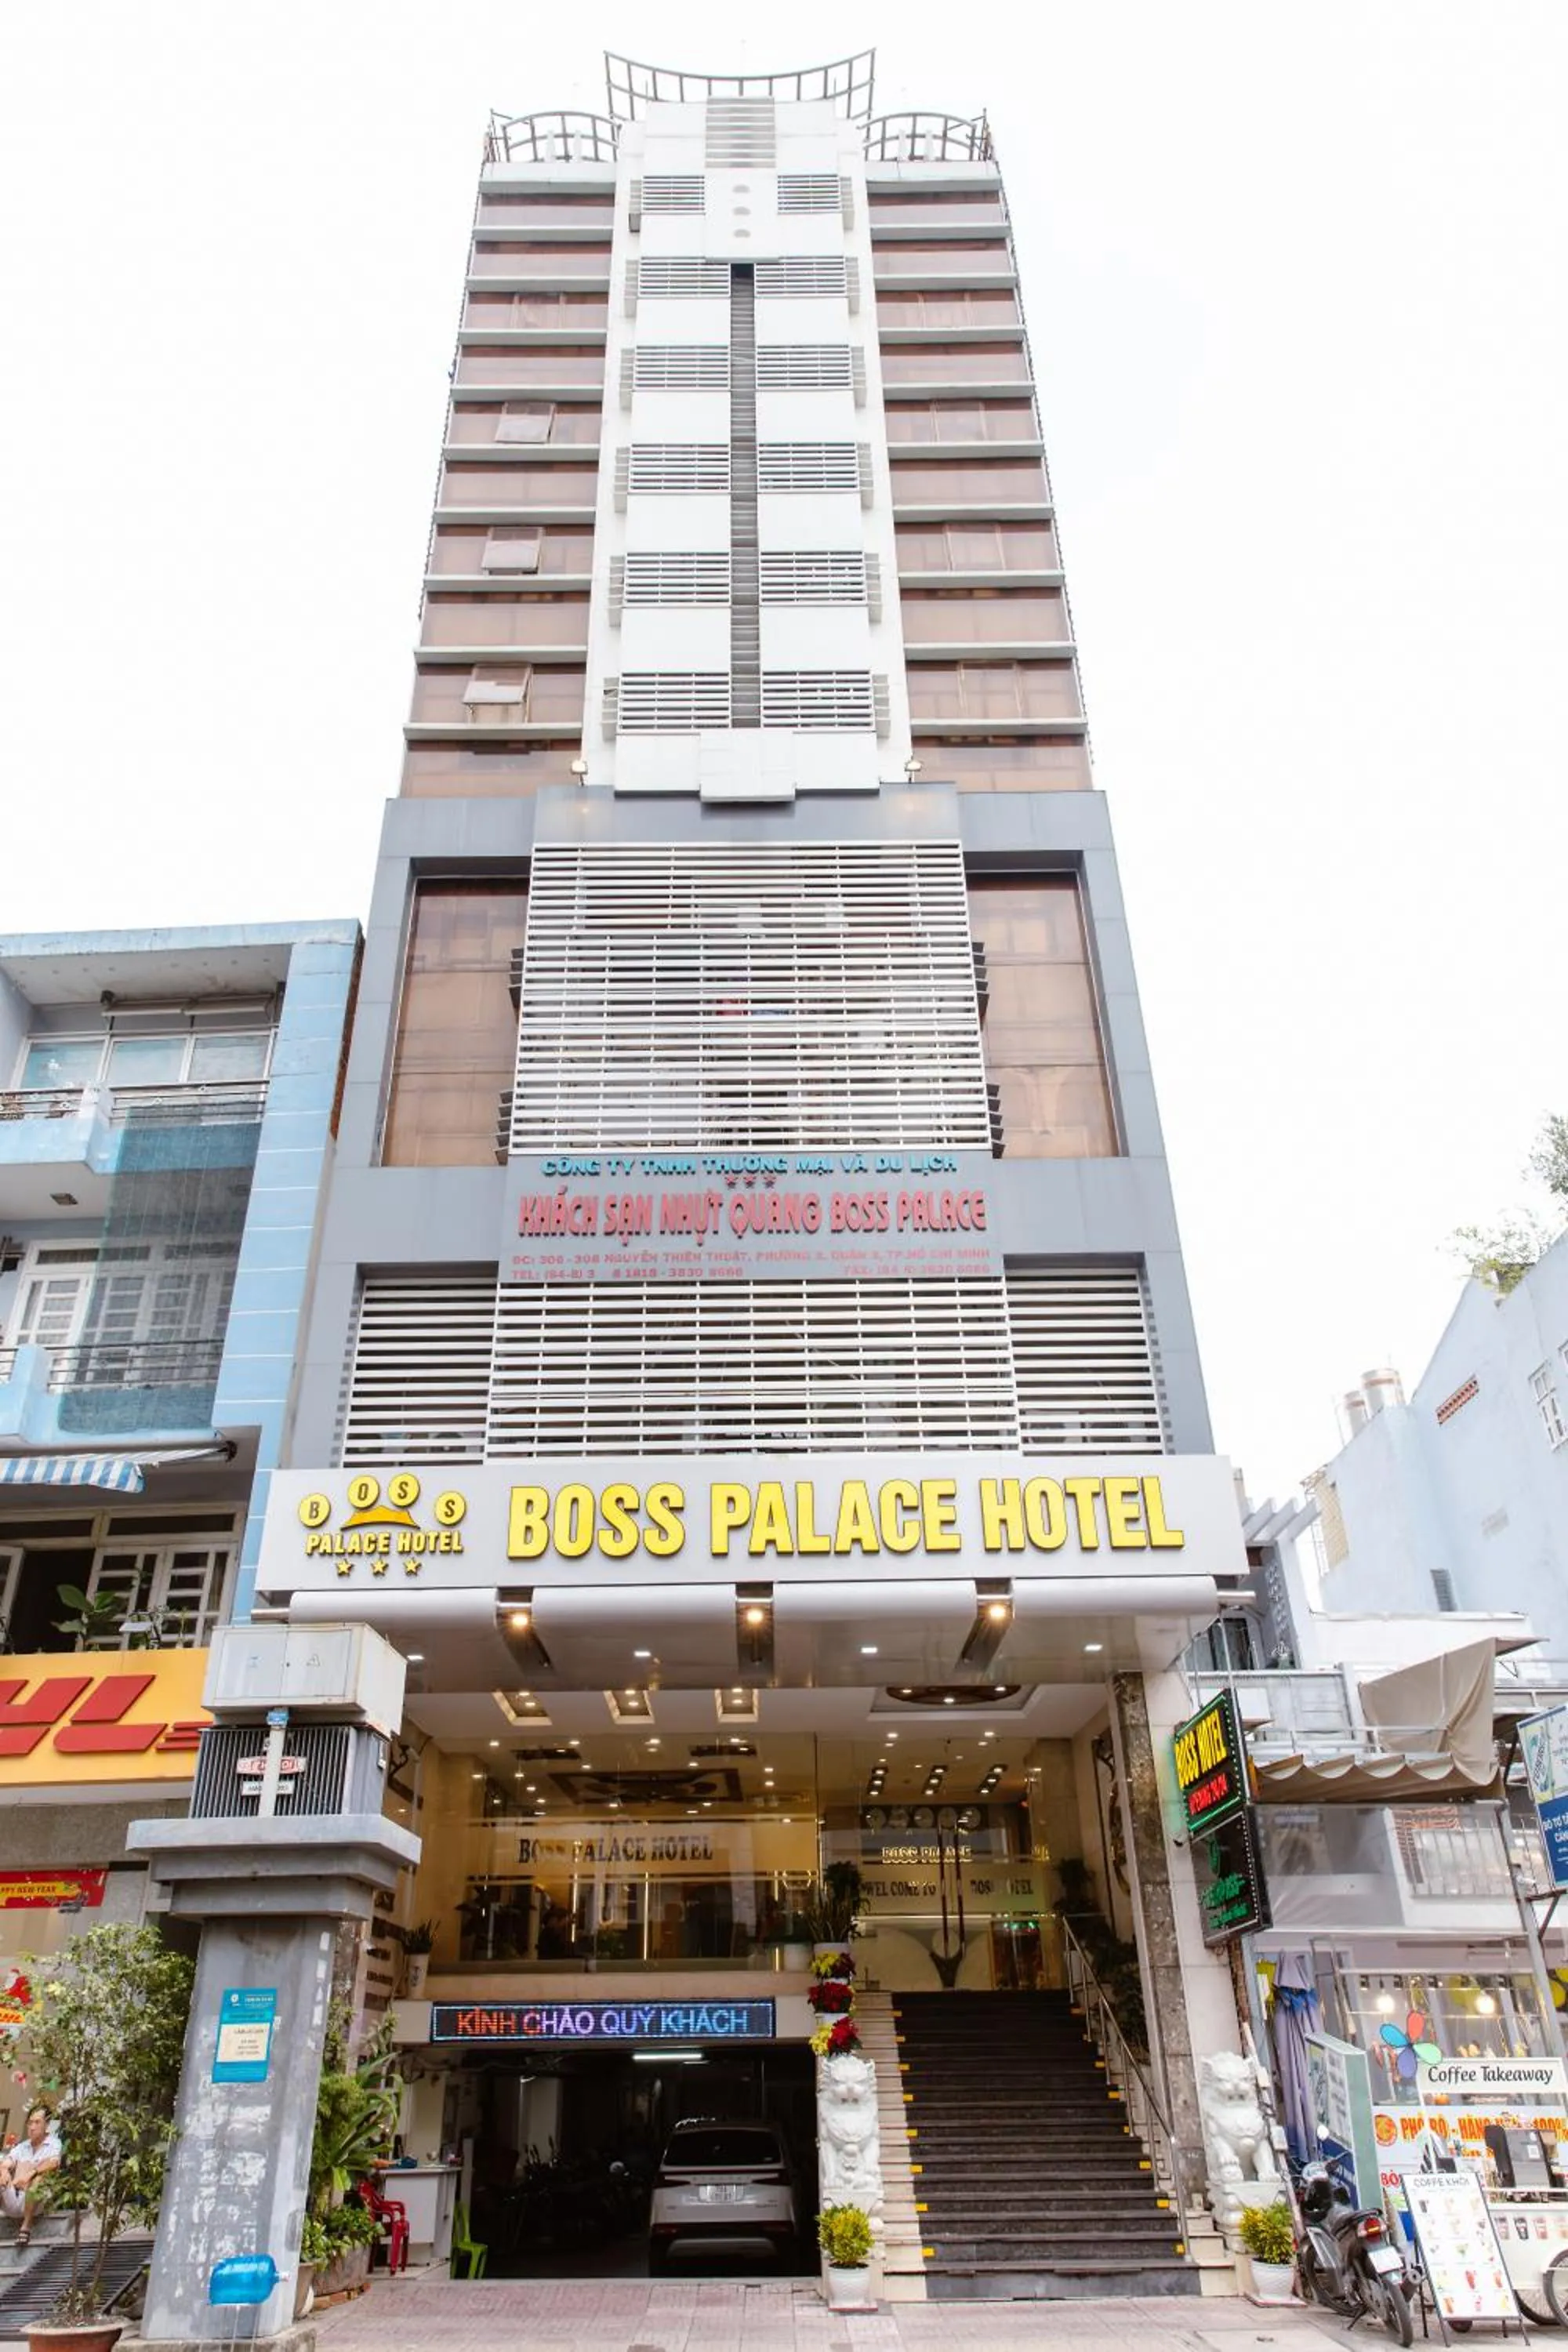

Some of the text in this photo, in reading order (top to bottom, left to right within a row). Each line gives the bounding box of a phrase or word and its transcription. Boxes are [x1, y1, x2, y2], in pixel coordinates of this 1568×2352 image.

[540, 1153, 957, 1176] CÔNG TY TNHH THƯƠNG MẠI VÀ DU LỊCH
[518, 1184, 599, 1236] KHÁCH
[604, 1193, 653, 1247] SẠN
[728, 1191, 822, 1240] QUANG
[830, 1191, 891, 1233] BOSS
[897, 1189, 987, 1232] PALACE
[507, 1475, 1185, 1559] BOSS PALACE HOTEL
[305, 1530, 465, 1555] PALACE HOTEL
[0, 1674, 168, 1755] HL
[1196, 1709, 1227, 1773] HOTEL
[652, 1834, 713, 1860] HOTEL
[457, 2003, 517, 2034] KÍNH
[523, 2003, 594, 2034] CHÀO
[662, 2003, 747, 2033] KHÁCH
[1428, 2065, 1554, 2085] Coffee Takeaway
